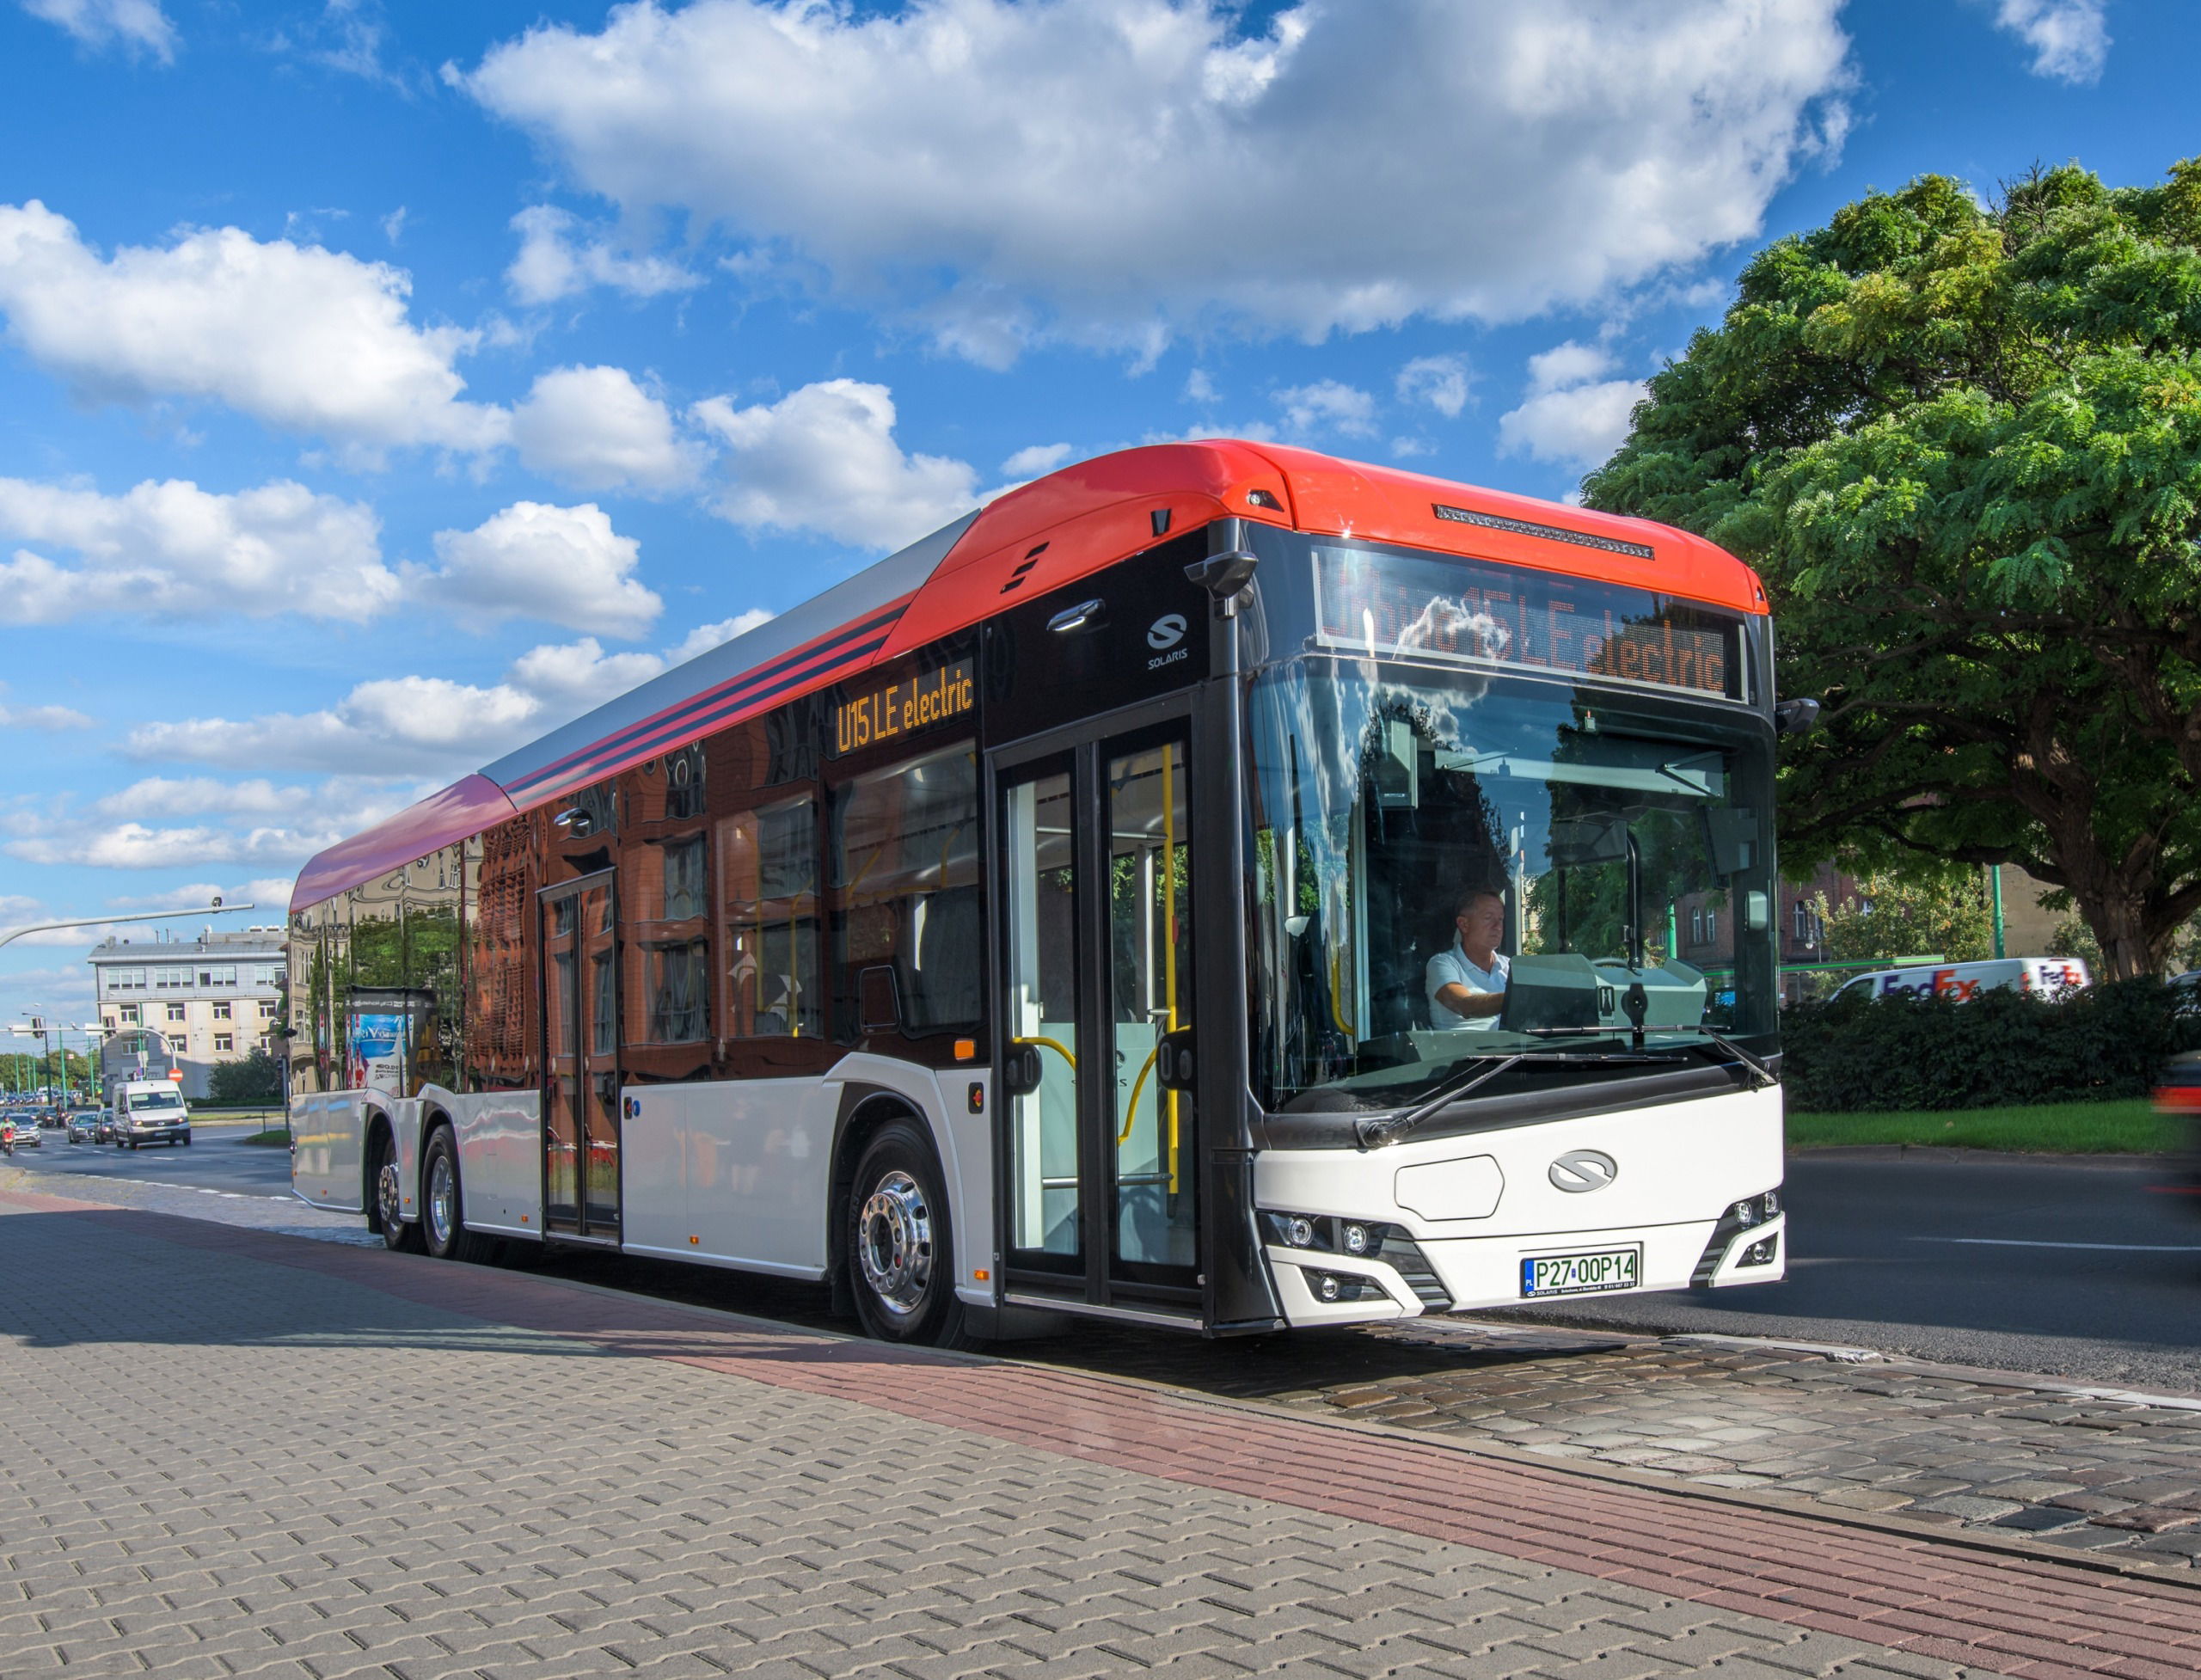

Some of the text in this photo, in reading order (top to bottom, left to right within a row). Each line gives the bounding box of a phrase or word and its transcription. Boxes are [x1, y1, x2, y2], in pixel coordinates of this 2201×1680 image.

[1148, 647, 1188, 671] SOLARIS
[1462, 586, 1513, 662] 15
[1518, 594, 1576, 671] LE
[1583, 609, 1725, 693] electric
[838, 666, 972, 753] U15 LE electric
